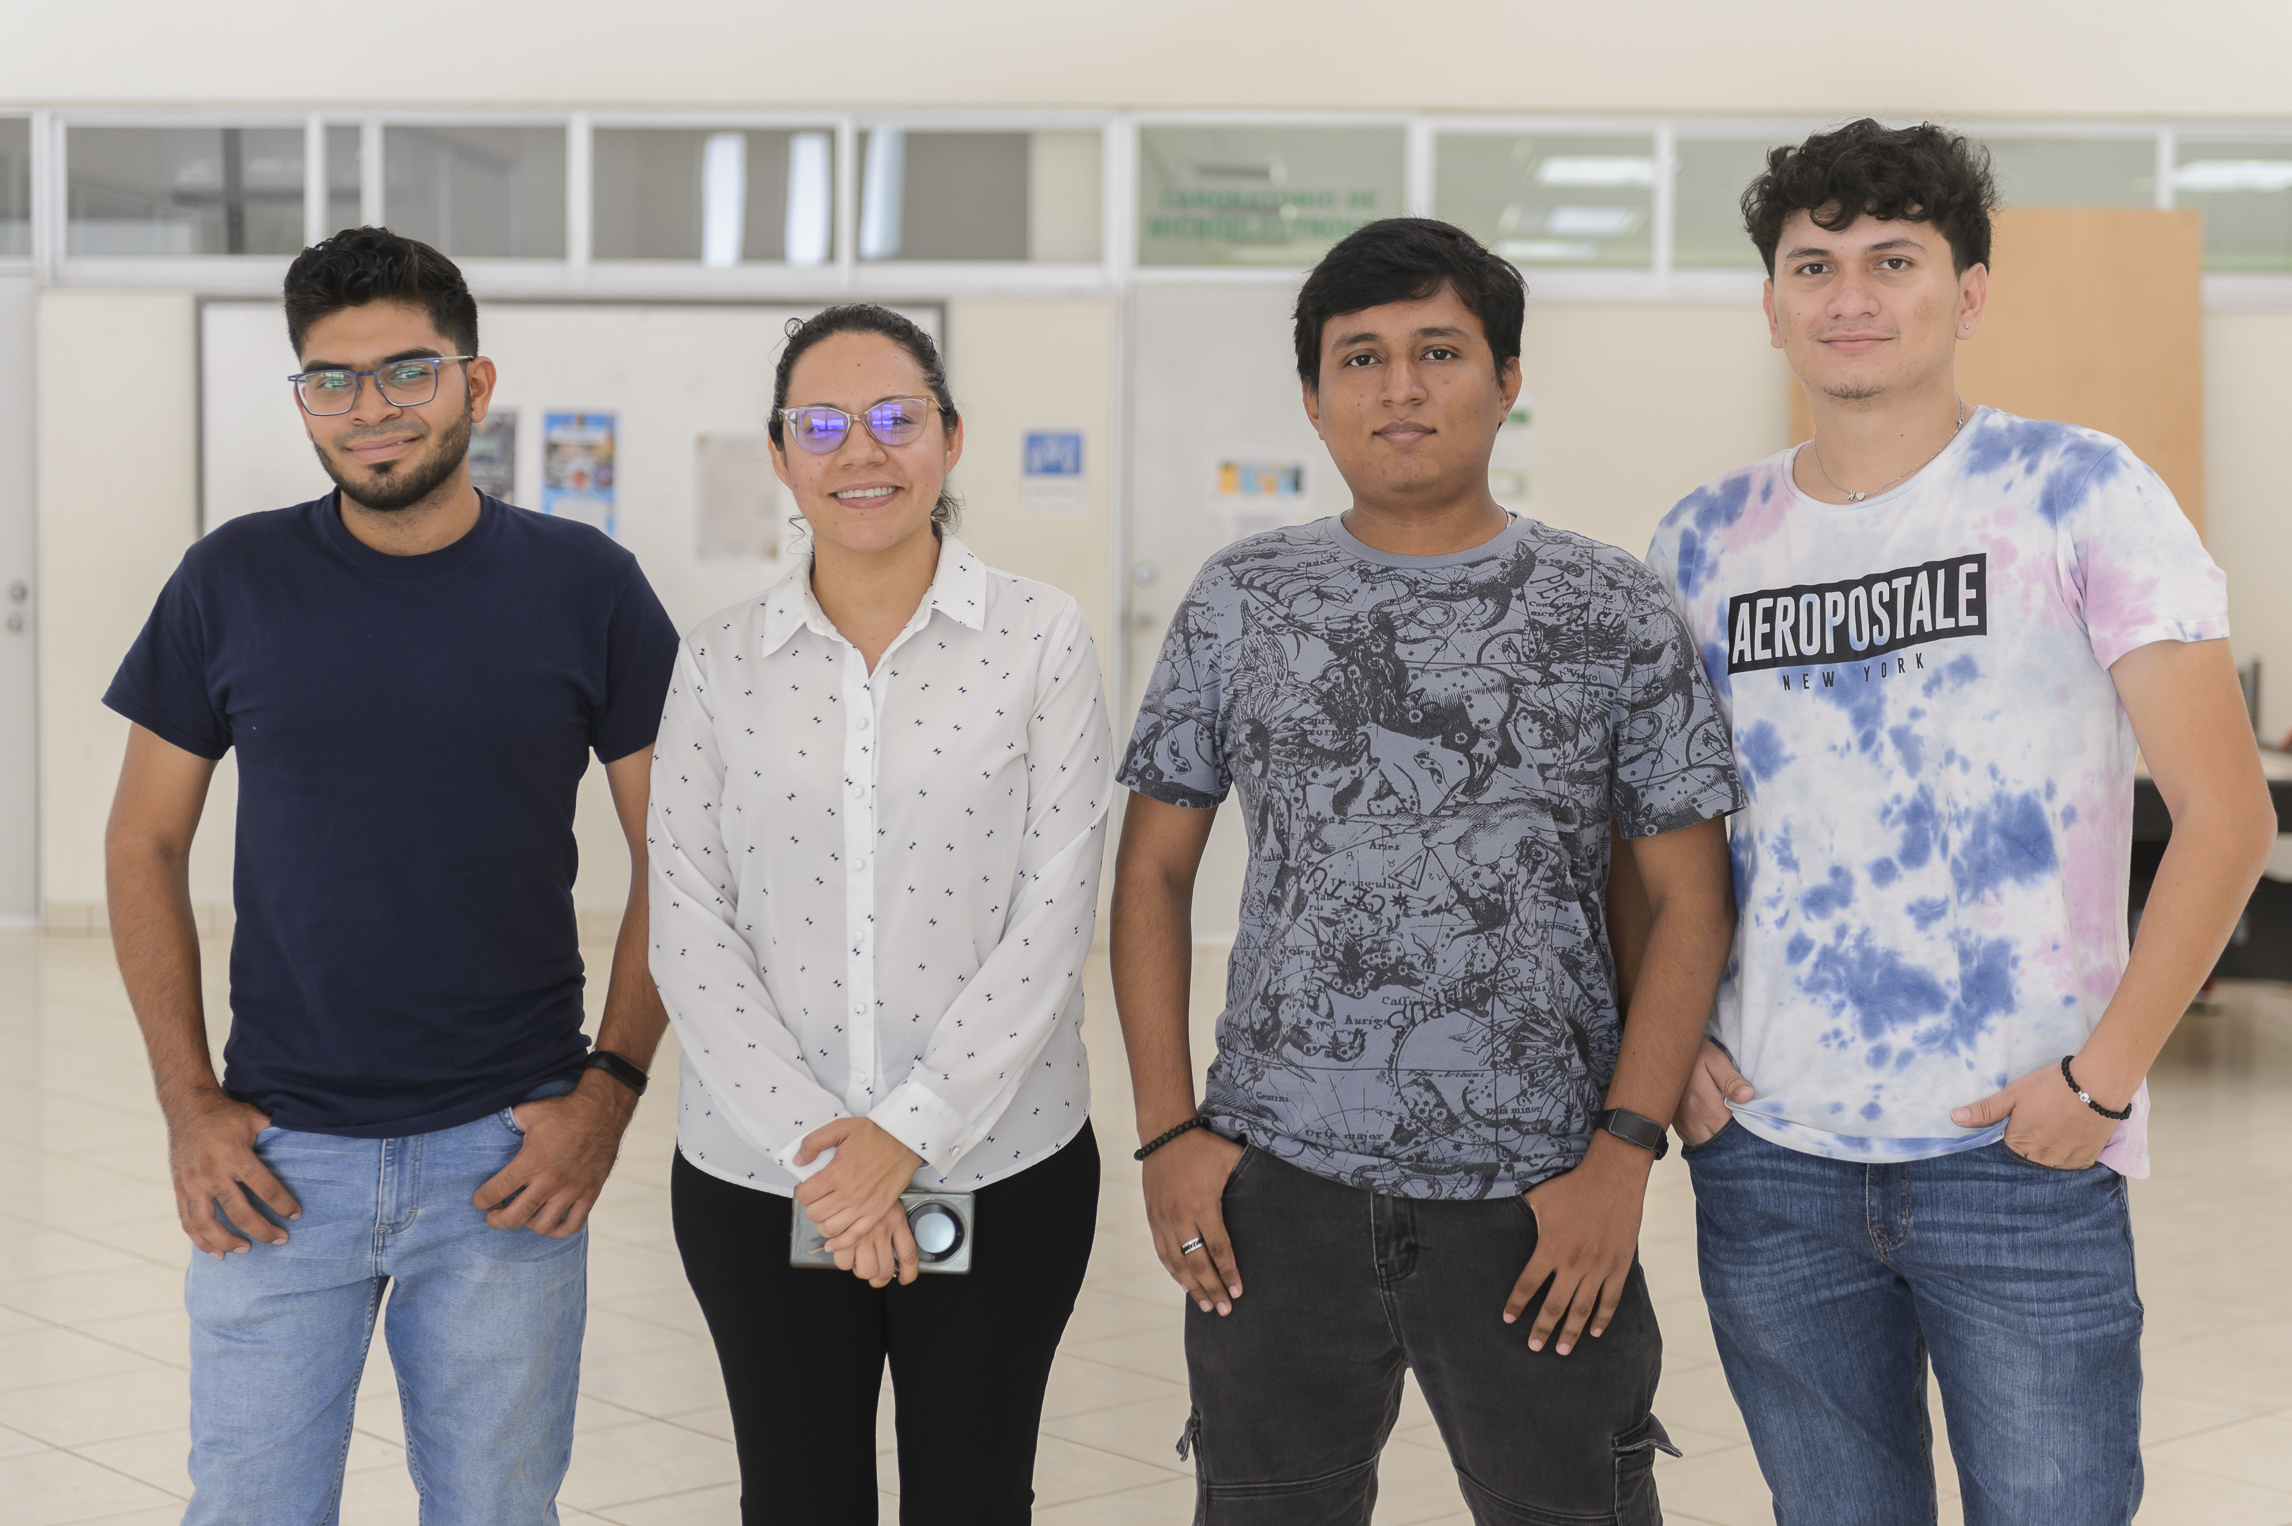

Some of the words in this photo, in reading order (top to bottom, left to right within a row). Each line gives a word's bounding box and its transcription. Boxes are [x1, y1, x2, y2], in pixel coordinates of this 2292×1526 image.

[1732, 562, 1979, 665] AEROPOSTALE
[1783, 671, 1835, 692] NEW
[1863, 652, 1925, 683] YORK
[1369, 840, 1400, 851] Aries
[1255, 1091, 1289, 1103] Gemini
